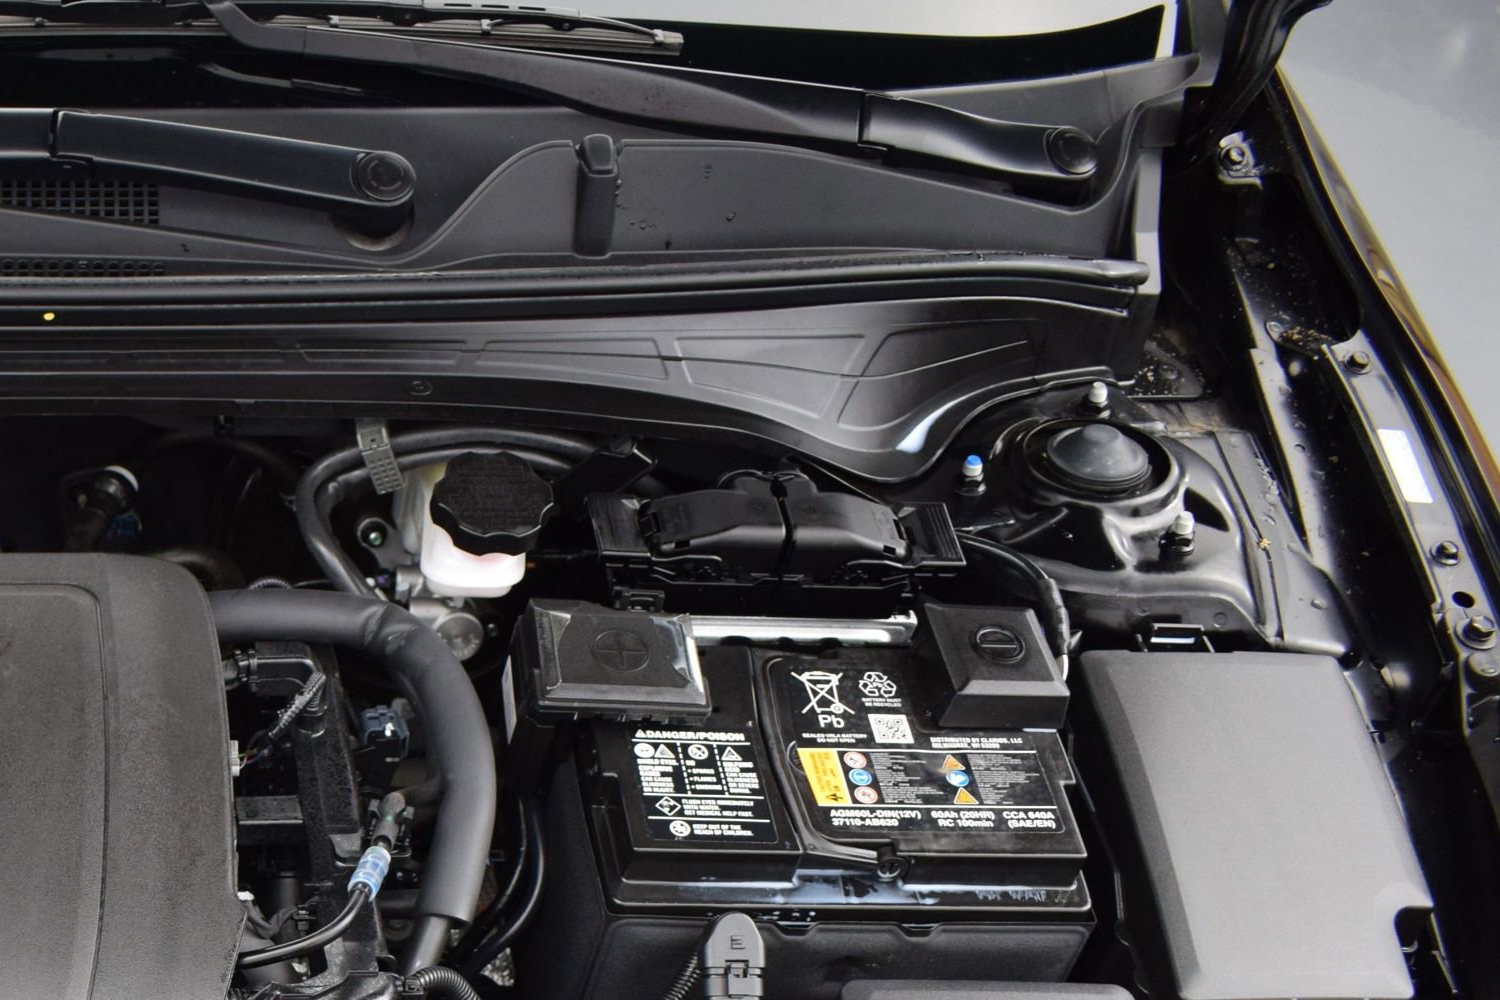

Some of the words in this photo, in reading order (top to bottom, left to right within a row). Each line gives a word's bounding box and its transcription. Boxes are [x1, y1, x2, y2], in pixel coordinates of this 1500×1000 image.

[818, 715, 845, 728] Pb
[646, 730, 745, 741] DANGER/POISON
[1002, 811, 1027, 819] CCA
[938, 819, 955, 827] RC
[956, 819, 994, 827] 100min
